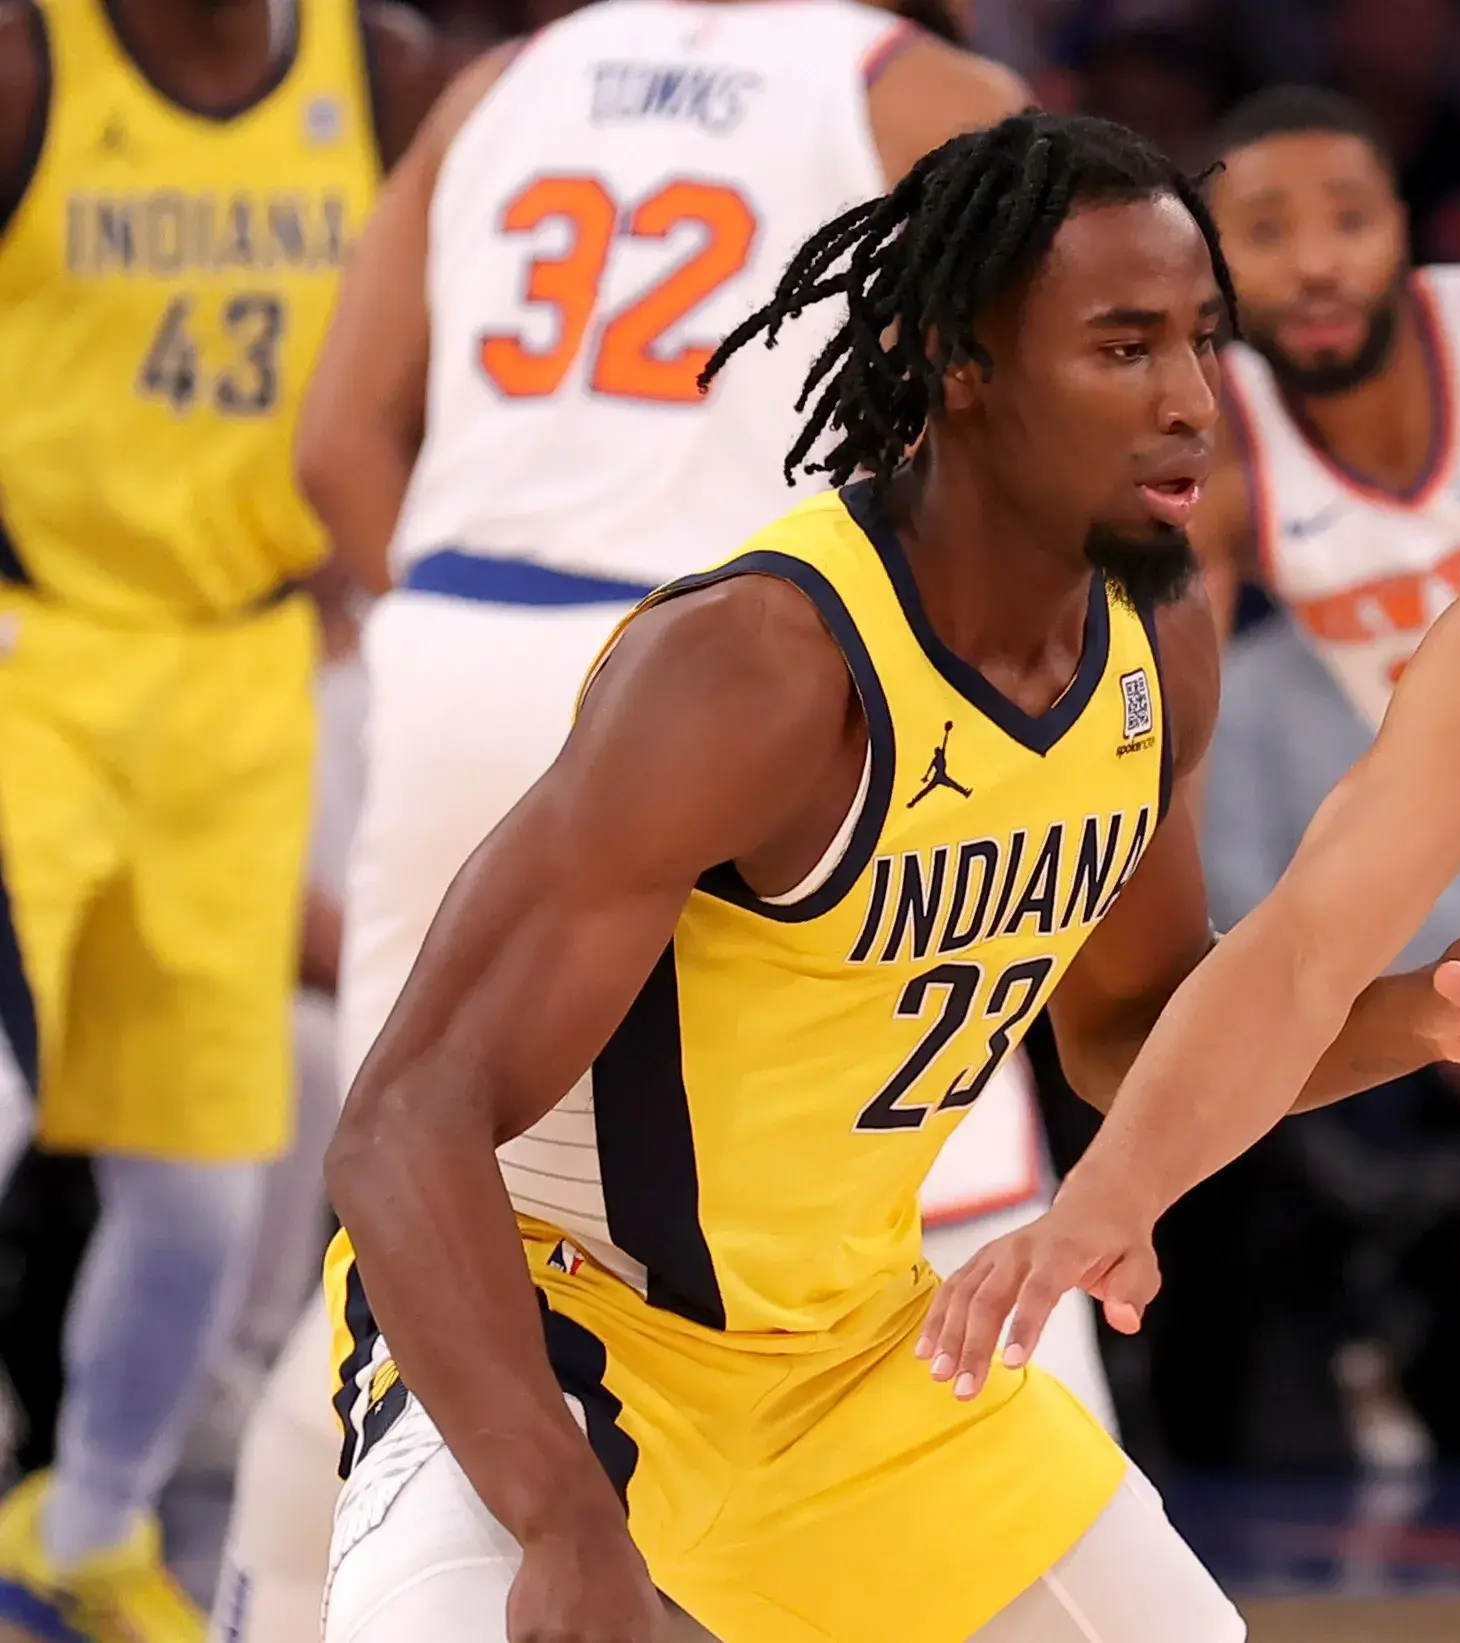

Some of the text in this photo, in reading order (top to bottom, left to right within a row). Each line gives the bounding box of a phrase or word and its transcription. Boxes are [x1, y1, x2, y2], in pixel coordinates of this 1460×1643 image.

[138, 292, 284, 416] 43
[476, 171, 758, 404] 32
[845, 803, 1150, 965] INDIANA
[851, 954, 1058, 1134] 23
